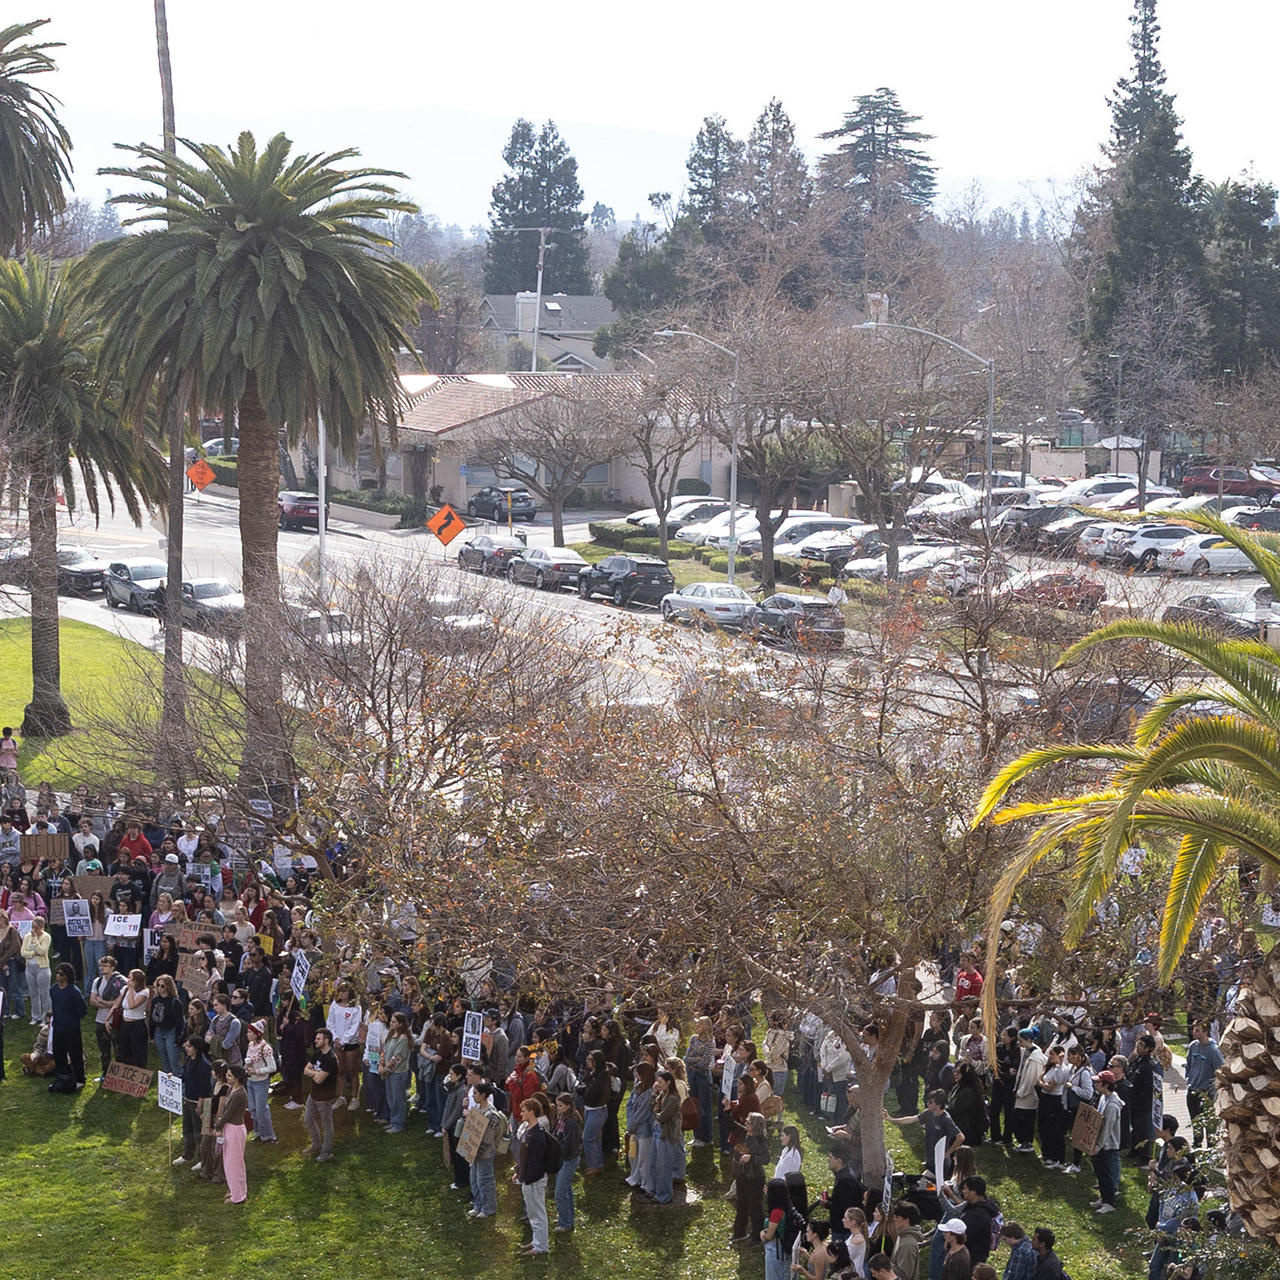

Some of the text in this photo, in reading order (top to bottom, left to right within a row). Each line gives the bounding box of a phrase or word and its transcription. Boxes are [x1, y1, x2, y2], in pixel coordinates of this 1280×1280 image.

[22, 835, 69, 858] ICE OUT
[464, 1036, 480, 1050] JUSTICE
[109, 1063, 152, 1086] NO ICE IN
[161, 1075, 181, 1092] PROTECT
[164, 1088, 174, 1097] OUR
